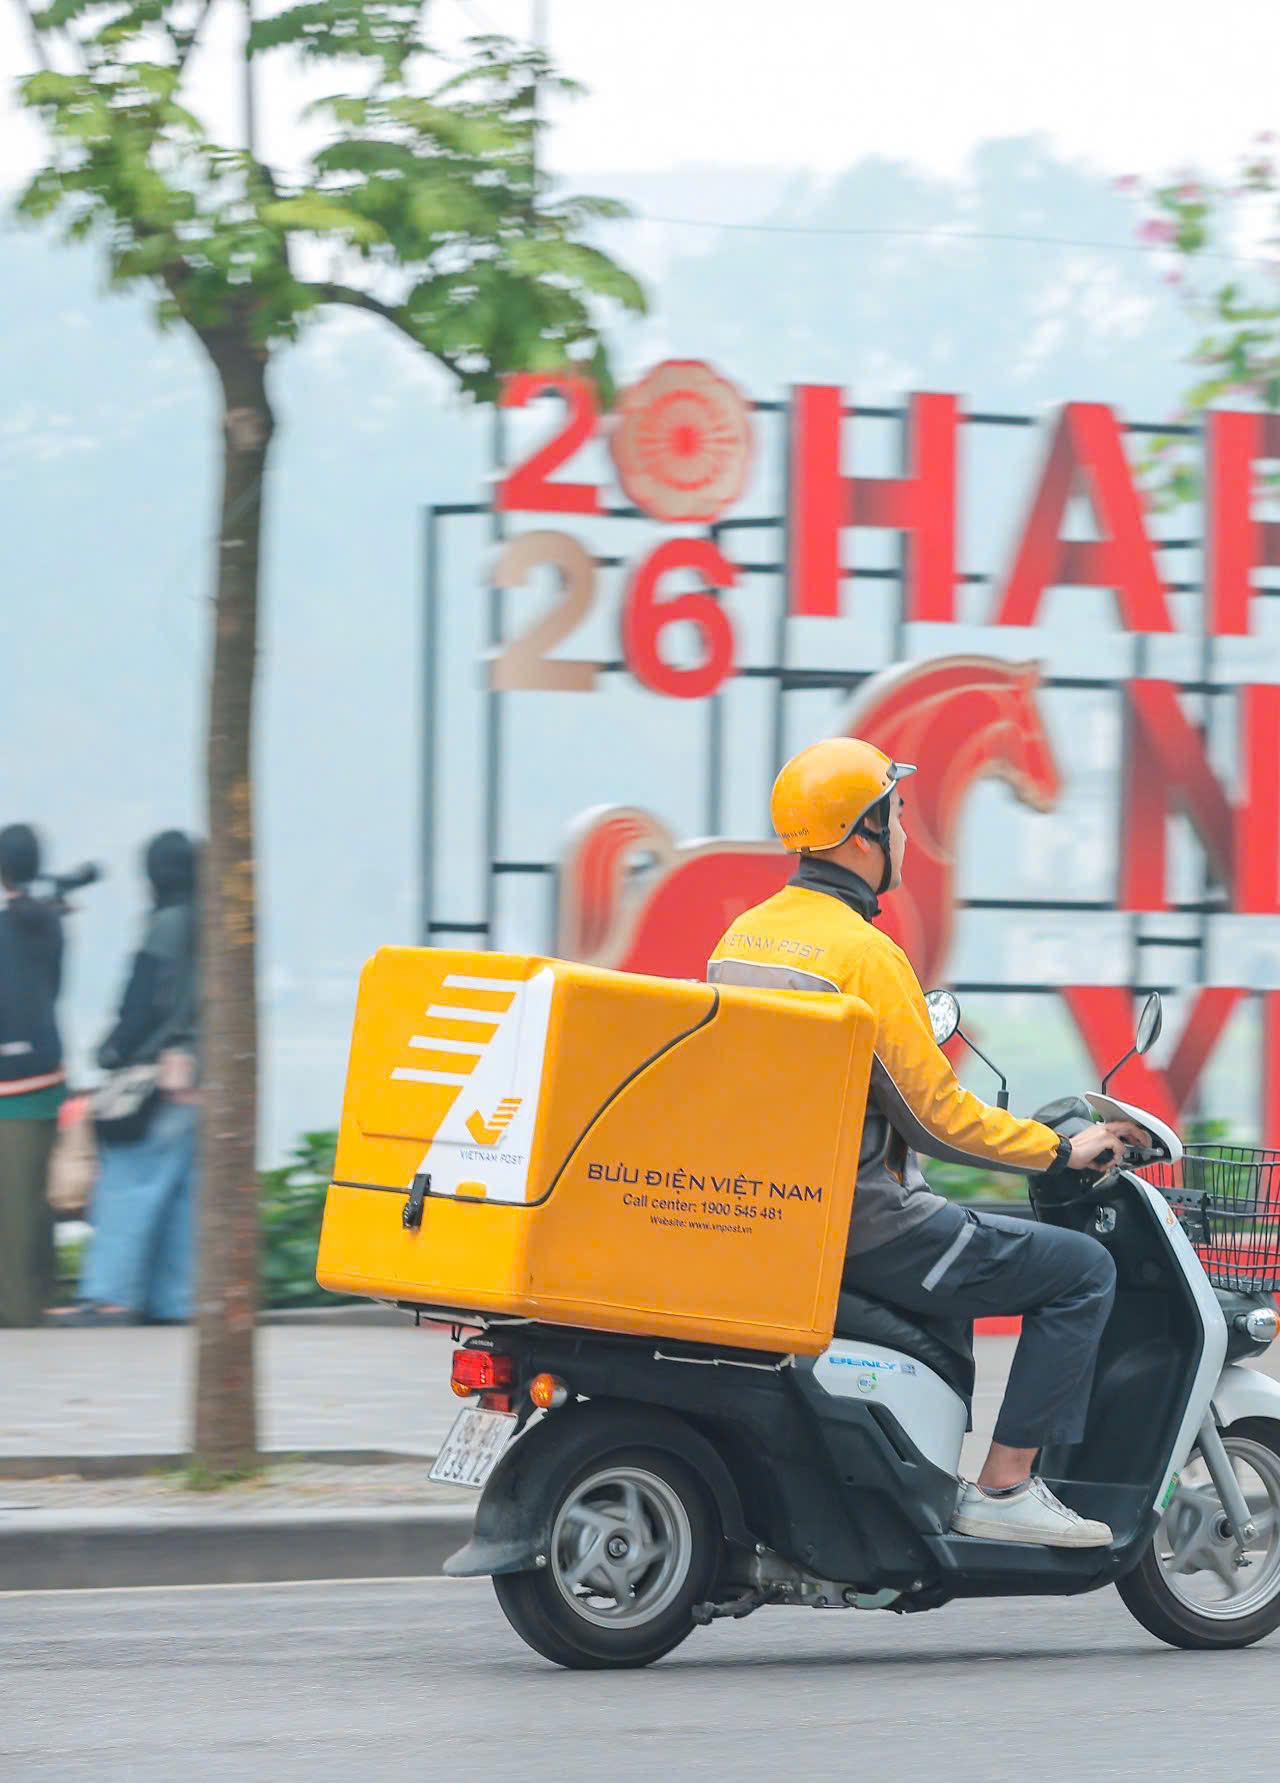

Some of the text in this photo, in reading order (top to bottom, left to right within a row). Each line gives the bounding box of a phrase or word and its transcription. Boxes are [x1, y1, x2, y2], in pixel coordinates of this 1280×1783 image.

[489, 531, 739, 699] 26
[778, 938, 825, 960] POST
[460, 1150, 526, 1165] VIETNAM POST
[587, 1163, 823, 1202] BƯU ĐIỆN VIỆT NAM
[622, 1193, 783, 1221] Call center: 1900 545 481
[649, 1215, 753, 1234] Website: www.vnpost.vn
